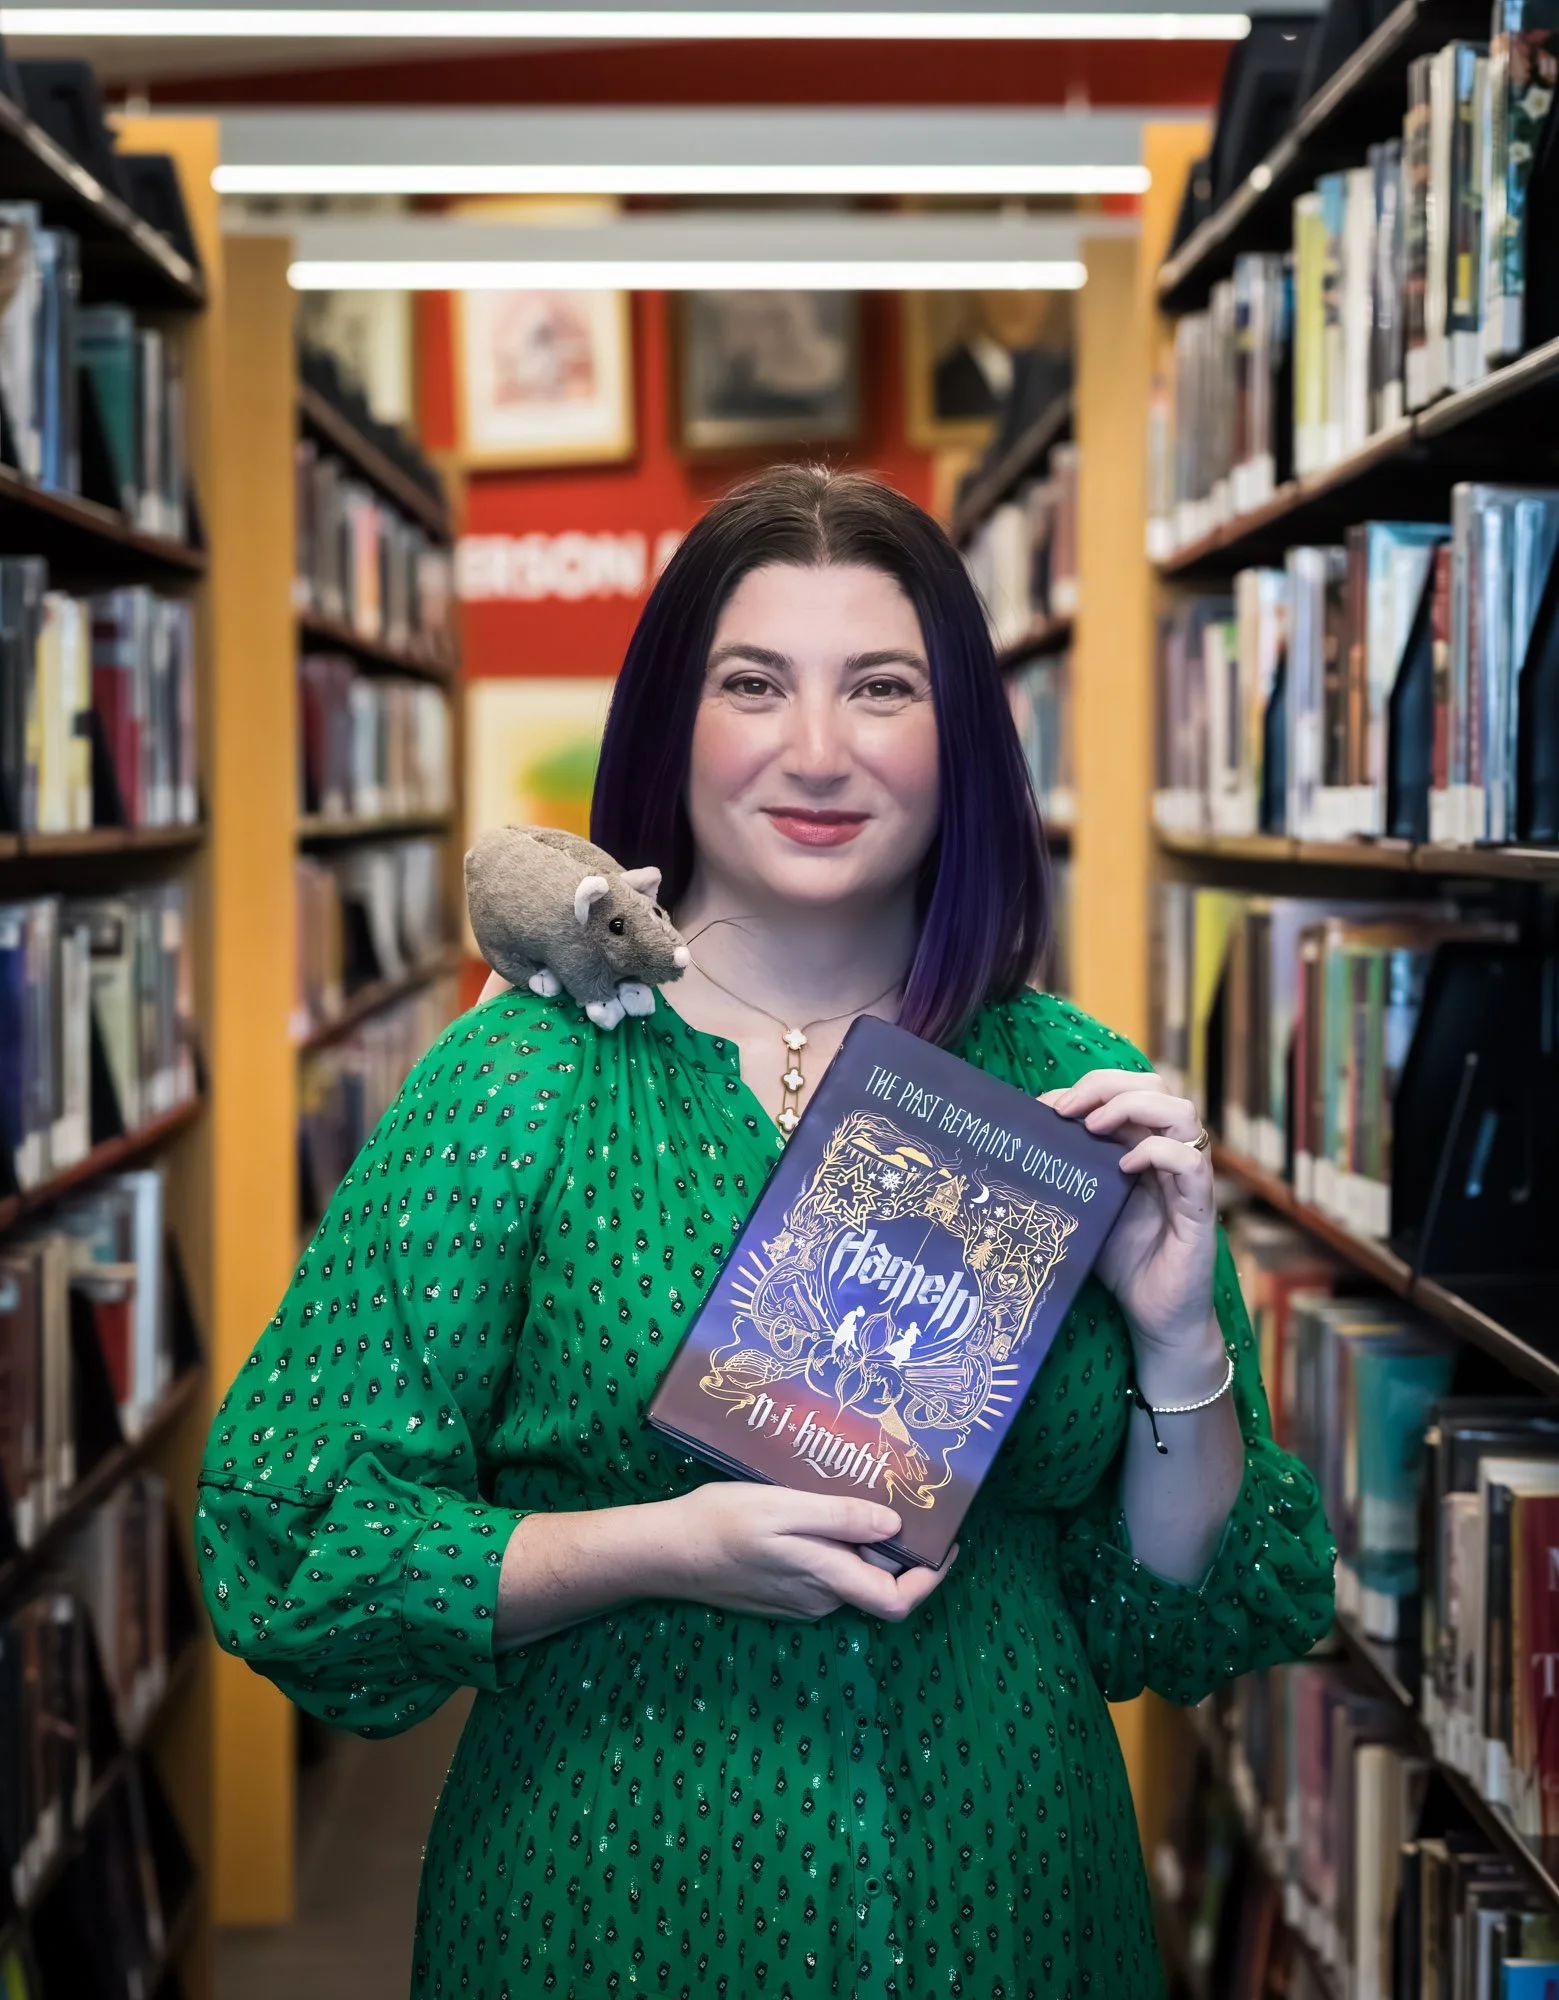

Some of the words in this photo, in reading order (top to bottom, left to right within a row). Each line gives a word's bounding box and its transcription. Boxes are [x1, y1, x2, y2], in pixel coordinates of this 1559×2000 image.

[865, 1065, 901, 1100] THE
[897, 1081, 943, 1122] PAST
[938, 1103, 1021, 1162] REMAINS
[1022, 1145, 1098, 1202] UNSUNG
[828, 1229, 979, 1346] Hameln
